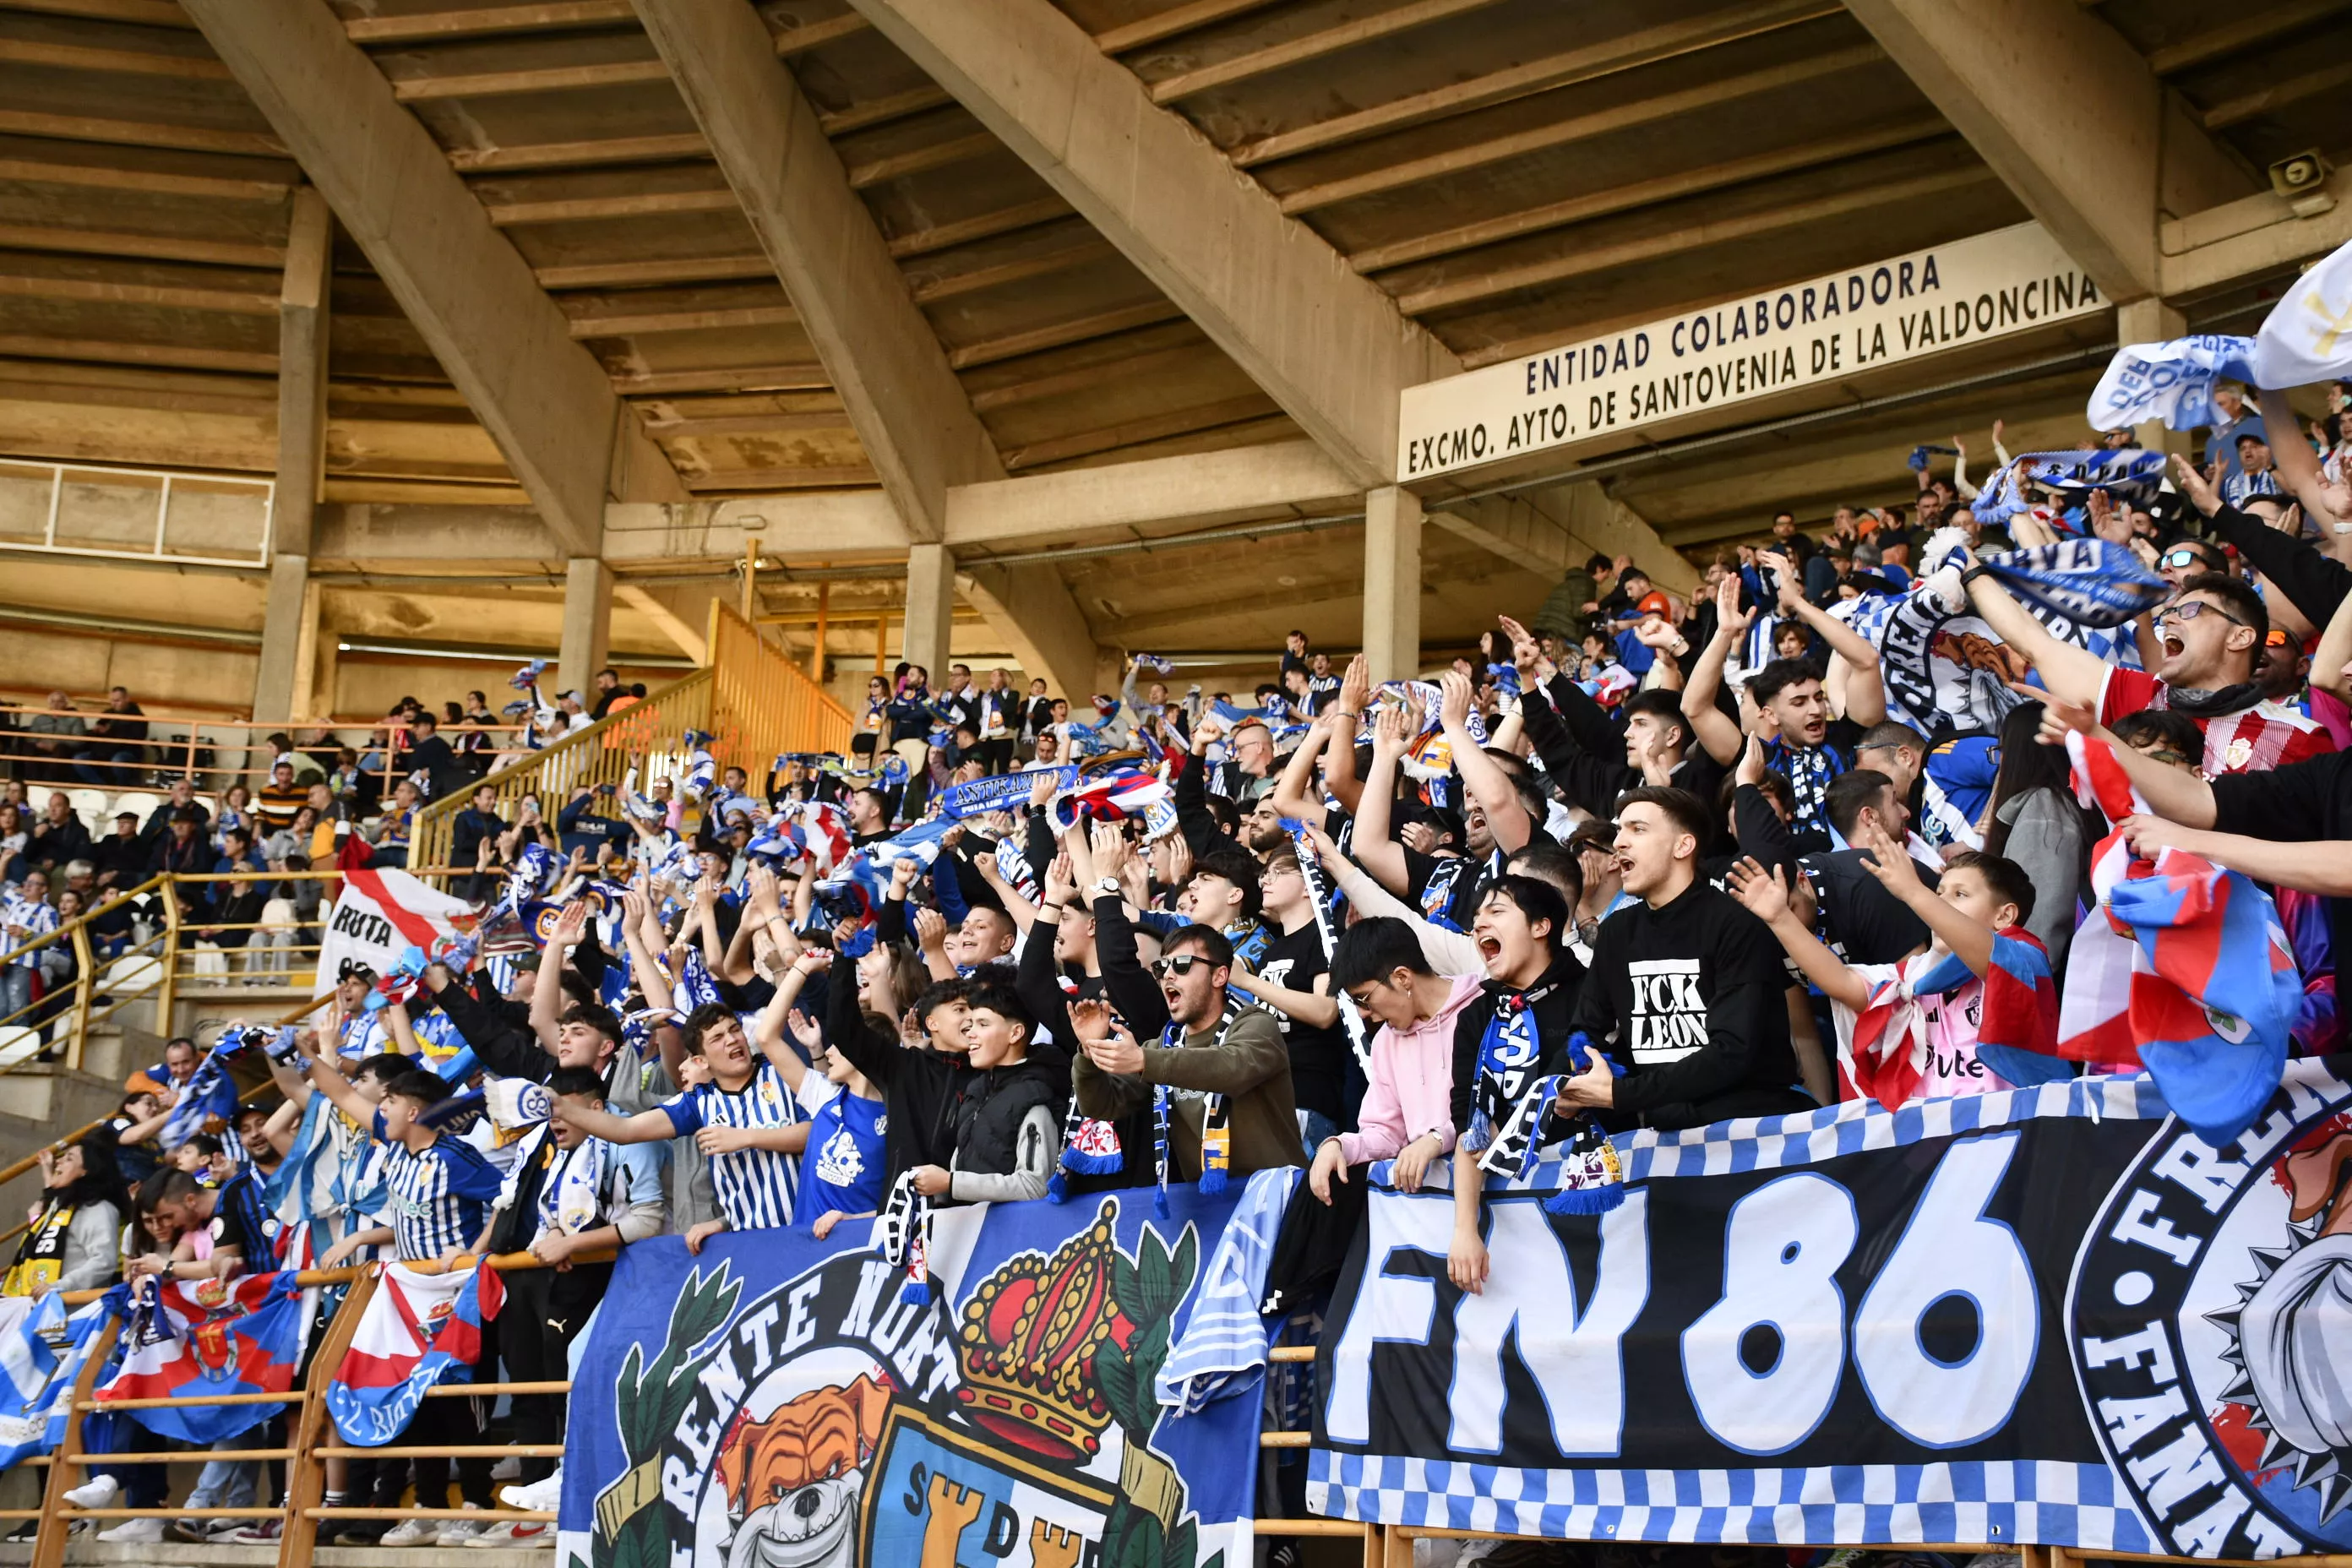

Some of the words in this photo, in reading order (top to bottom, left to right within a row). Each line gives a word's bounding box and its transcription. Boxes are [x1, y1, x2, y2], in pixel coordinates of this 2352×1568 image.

[1526, 333, 1650, 395] ENTIDAD
[1671, 254, 1941, 357] COLABORADORA
[1407, 423, 1494, 474] EXCMO.
[1506, 403, 1576, 450] AYTO.
[1589, 390, 1616, 430] DE
[1630, 346, 1797, 421] SANTOVENIA
[1810, 334, 1841, 376] DE
[1856, 322, 1887, 365] LA
[1899, 271, 2099, 351] VALDONCINA
[333, 904, 392, 948] RUTA
[1630, 973, 1707, 1015] FCK
[1630, 1005, 1710, 1049] LEÓN
[1325, 1184, 1651, 1459] FN
[1680, 1129, 2042, 1456] 86
